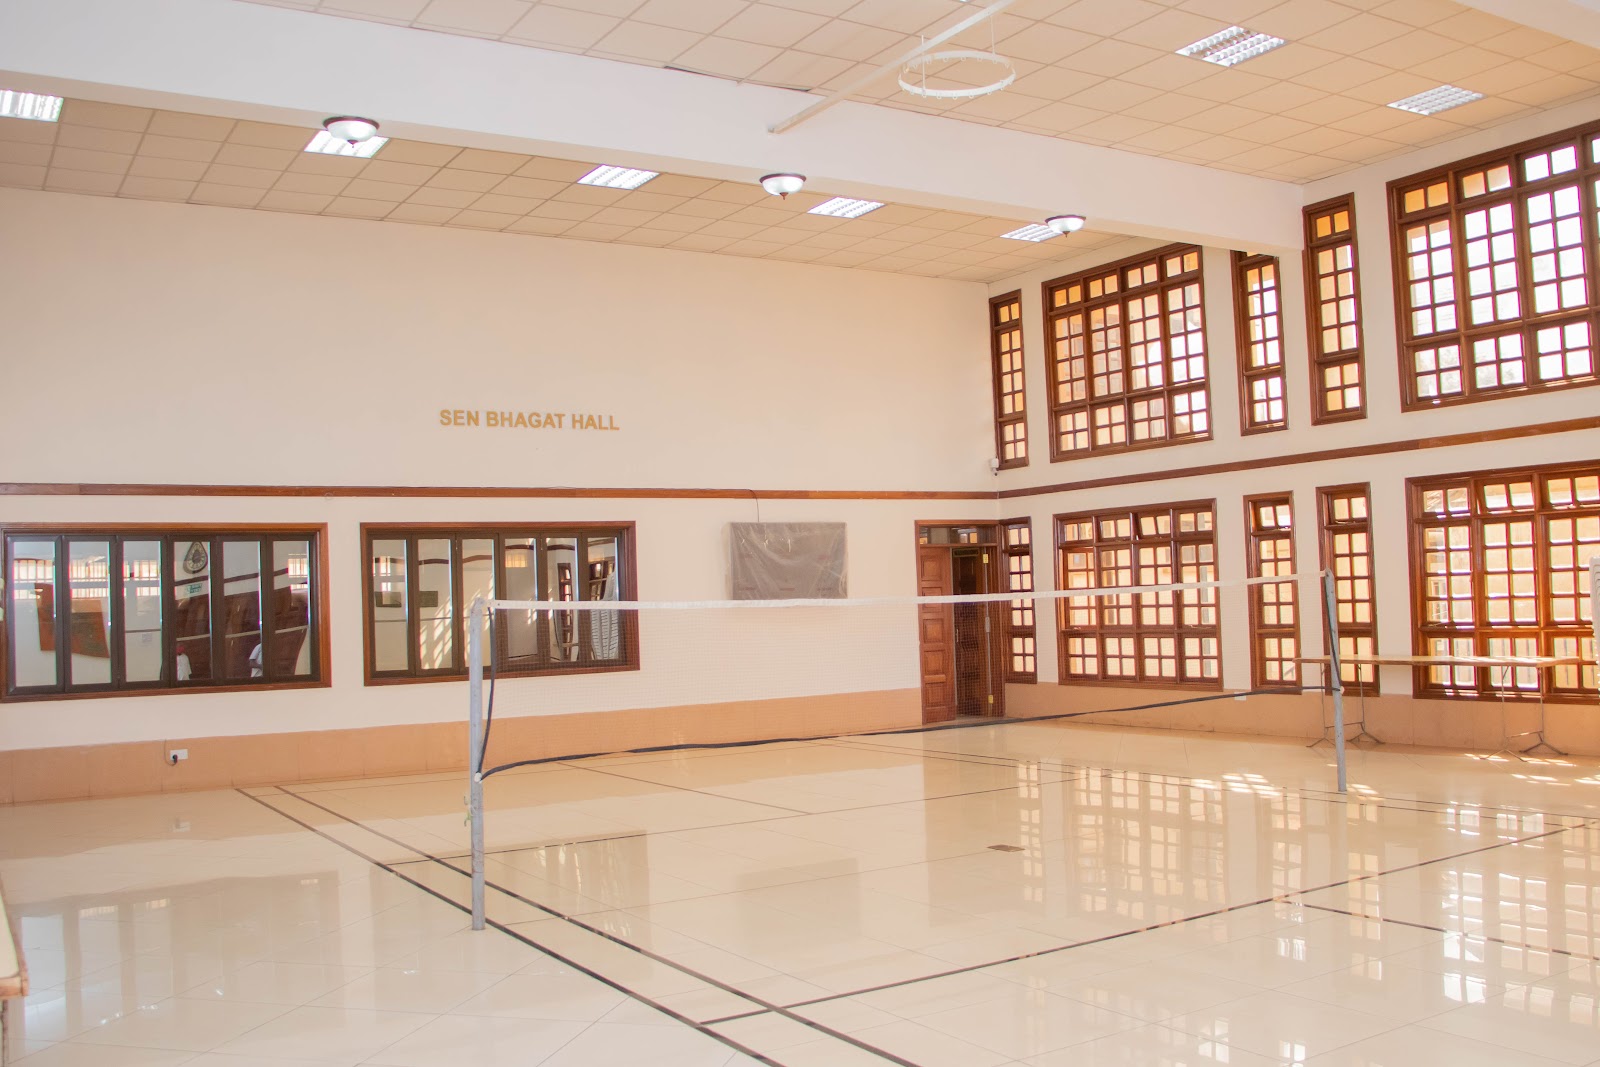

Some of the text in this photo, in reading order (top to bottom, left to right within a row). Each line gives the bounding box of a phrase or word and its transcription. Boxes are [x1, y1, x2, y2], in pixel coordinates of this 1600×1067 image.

[439, 409, 621, 431] SEN BHAGAT HALL
